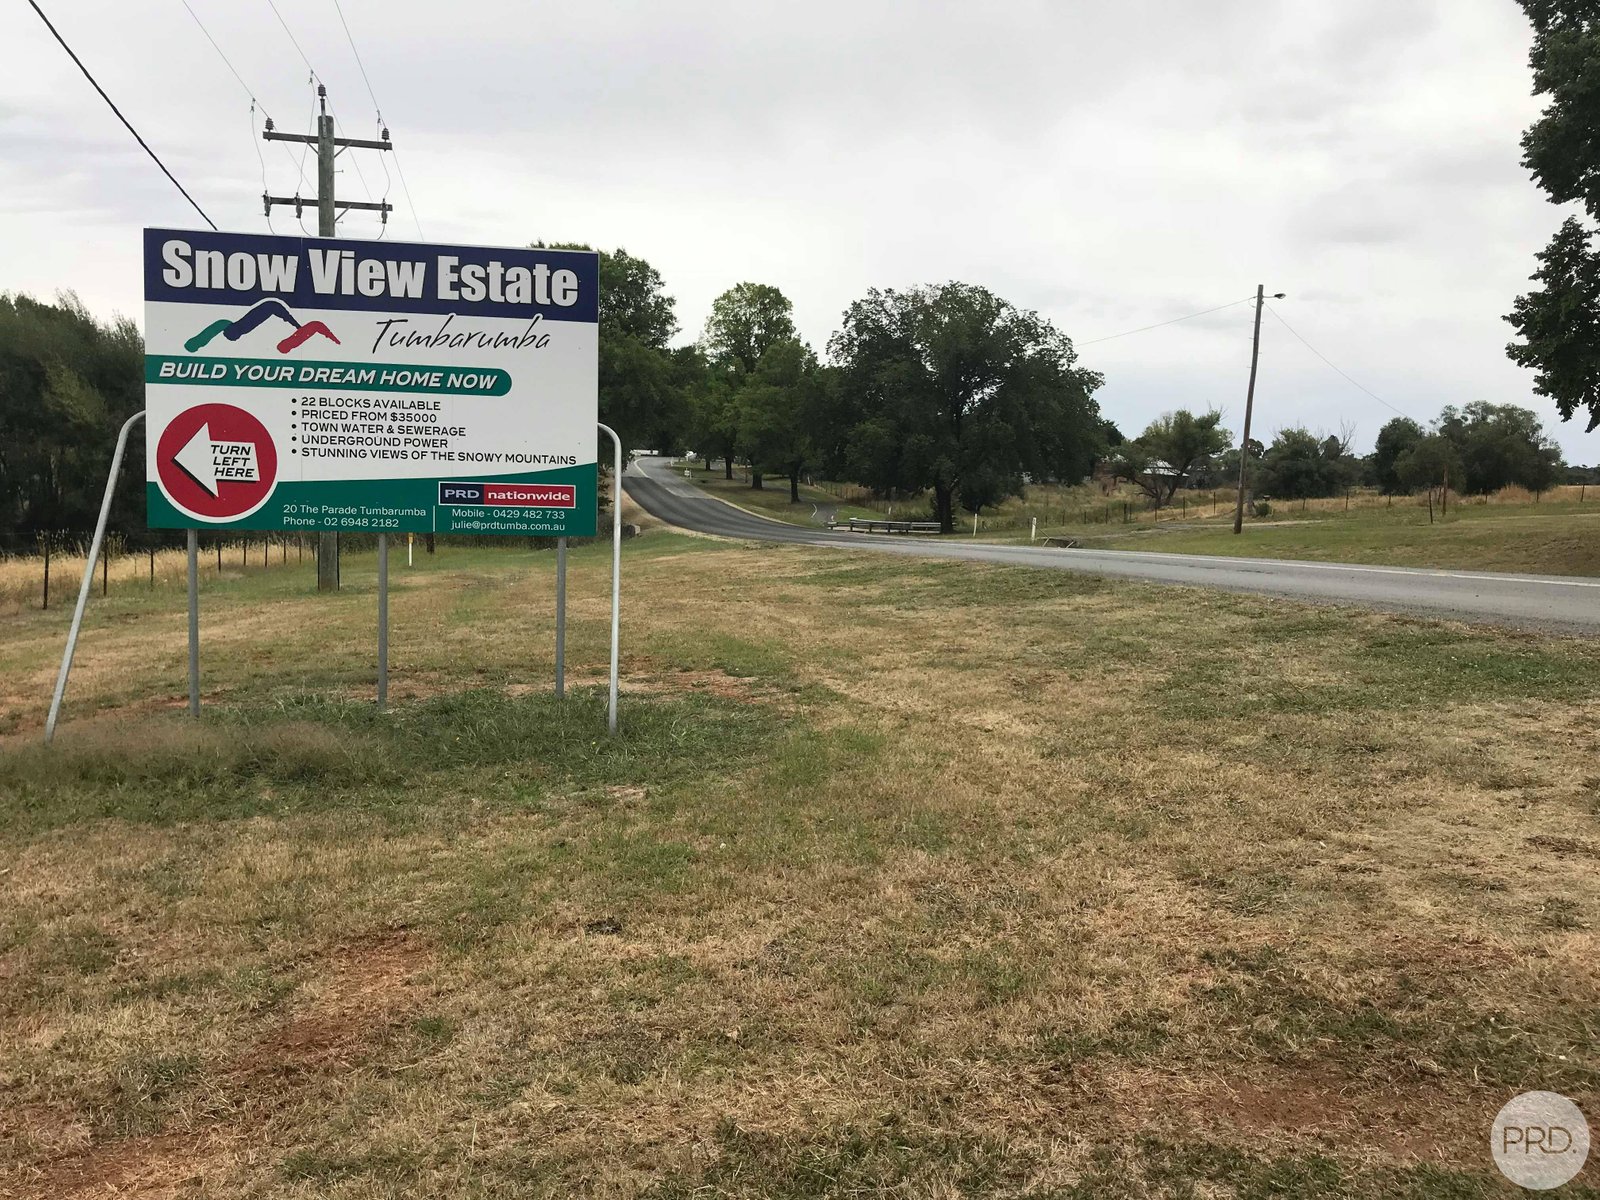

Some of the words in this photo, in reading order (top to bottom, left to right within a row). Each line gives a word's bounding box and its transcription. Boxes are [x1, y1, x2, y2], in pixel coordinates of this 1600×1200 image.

[162, 239, 298, 292] Snow
[308, 248, 426, 298] View
[437, 255, 578, 307] Estate
[372, 314, 551, 354] Tumbarumba
[159, 362, 227, 380] BUILD
[234, 364, 295, 382] YOUR
[299, 368, 376, 384] DREAM
[380, 370, 444, 388] HOME
[446, 373, 498, 390] NOW
[301, 397, 316, 406] 22
[319, 398, 371, 408] BLOCKS
[373, 399, 441, 410] AVAILABLE
[302, 410, 348, 420] PRICED
[352, 411, 388, 421] FROM
[390, 412, 437, 423] $35000
[301, 422, 338, 432] TOWN
[341, 424, 384, 434] WATER
[386, 425, 395, 434] &
[397, 425, 466, 436] SEWERAGE
[301, 435, 401, 446] UNDERGROUND
[404, 438, 448, 448] POWER
[211, 444, 251, 456] TURN
[213, 456, 250, 466] LEFT
[301, 448, 368, 458] STUNNING
[370, 450, 408, 460] VIEWS
[411, 450, 428, 460] OF
[431, 451, 455, 461] THE
[458, 452, 502, 463] SNOWY
[505, 454, 577, 465] MOUNTAINS
[214, 467, 255, 478] HERE
[444, 489, 480, 498] PRD
[488, 491, 571, 500] nationwide
[283, 504, 298, 514] 20
[300, 504, 318, 514] The
[322, 506, 358, 514] Parade
[360, 506, 426, 516] Tumbarumba
[452, 508, 485, 518] Mobile
[493, 510, 520, 518] 0429
[522, 510, 542, 519] 482
[546, 510, 565, 520] 733
[283, 516, 316, 526] Phone
[324, 518, 338, 526] 02
[340, 518, 369, 526] 6948
[371, 518, 399, 528] 2182
[450, 520, 566, 530] julie@prdtumba.com.au
